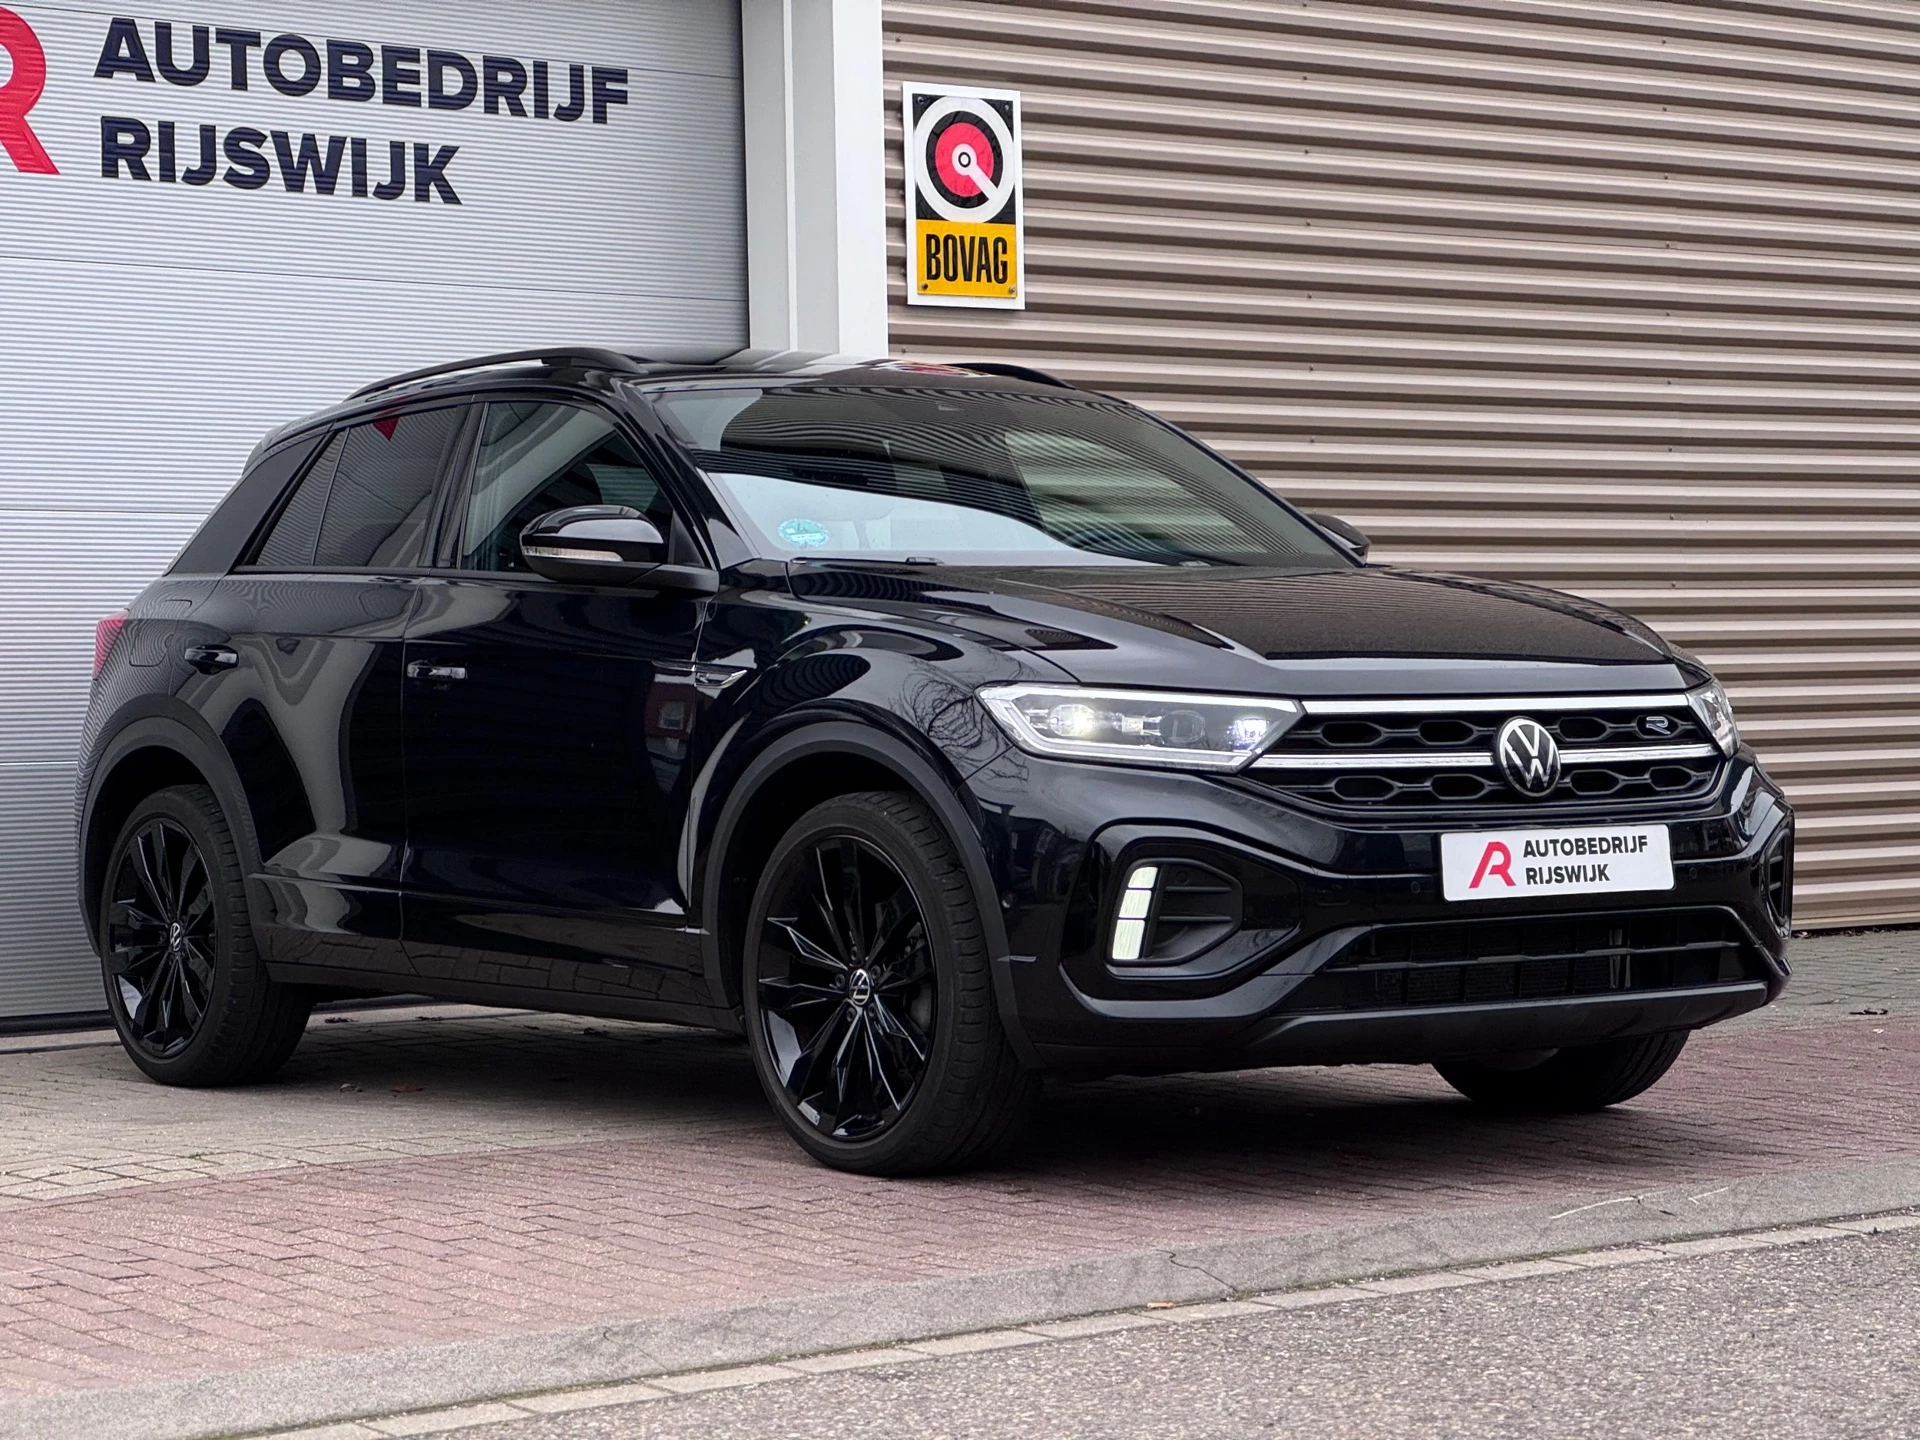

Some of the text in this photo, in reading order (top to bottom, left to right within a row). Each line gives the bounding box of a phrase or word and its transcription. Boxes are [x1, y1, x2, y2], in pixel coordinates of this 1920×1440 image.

[94, 17, 629, 125] AUTOBEDRIJF
[100, 115, 463, 205] RIJSWIJK
[925, 233, 1009, 285] BOVAG
[1523, 835, 1648, 858] AUTOBEDRIJF
[1525, 864, 1610, 885] RIJSWIJK
